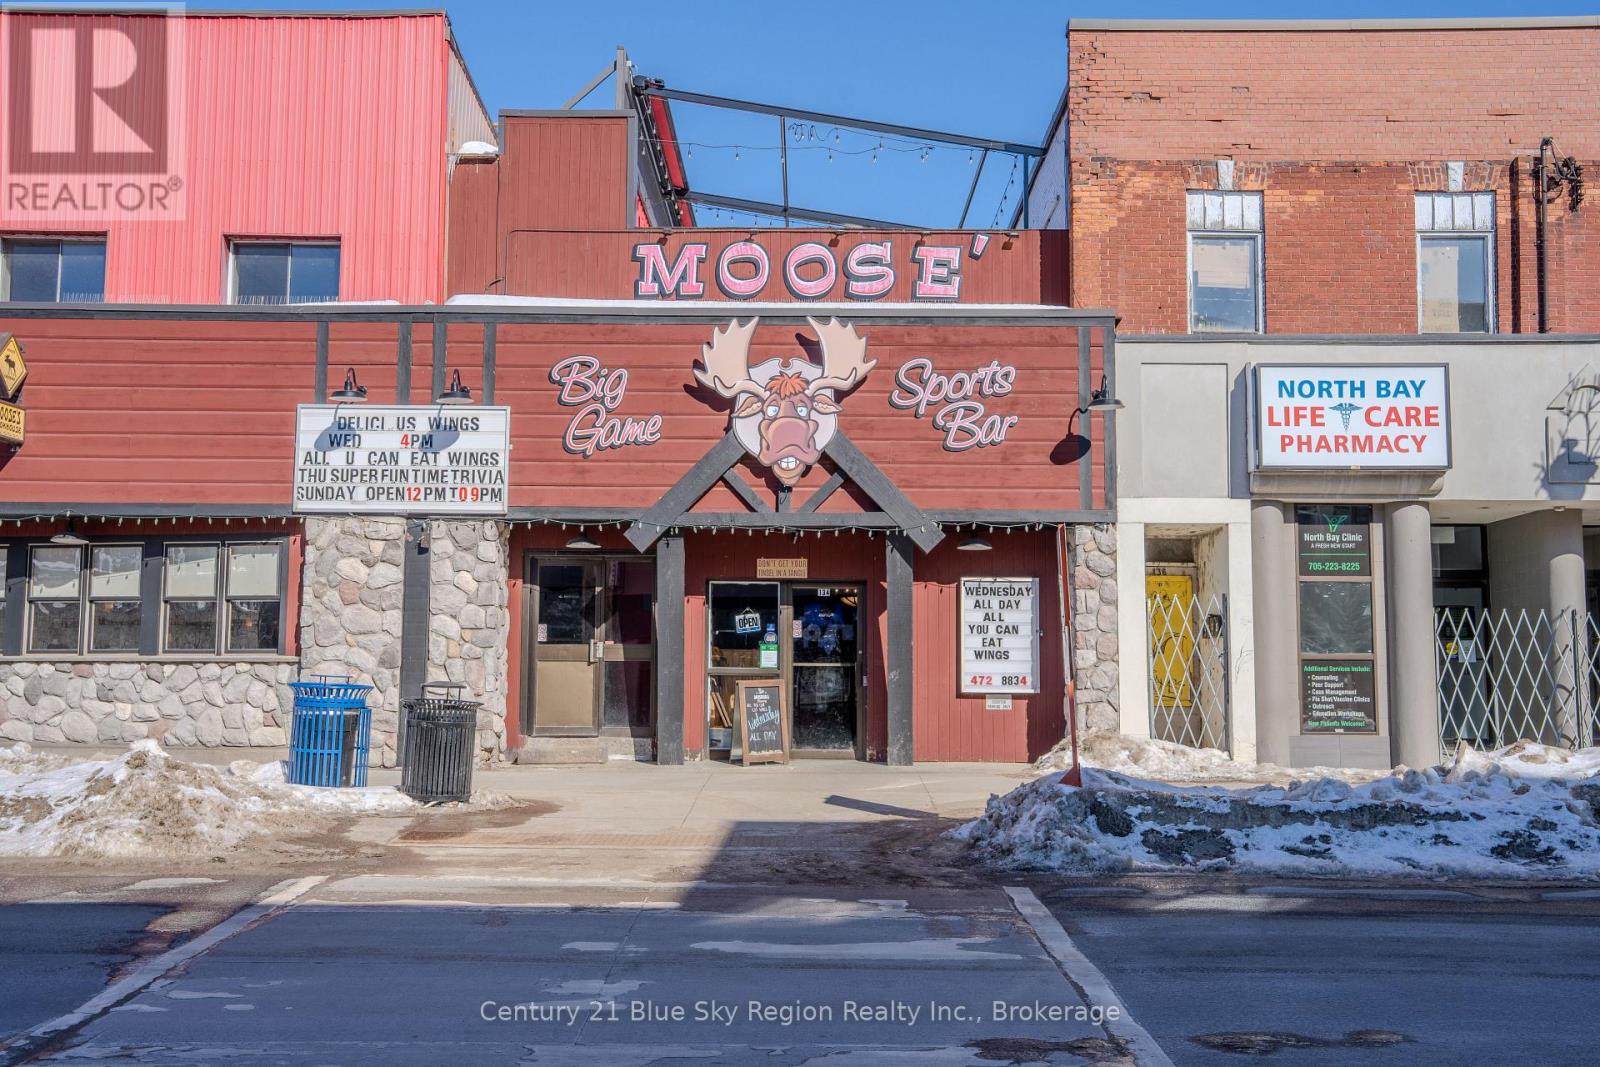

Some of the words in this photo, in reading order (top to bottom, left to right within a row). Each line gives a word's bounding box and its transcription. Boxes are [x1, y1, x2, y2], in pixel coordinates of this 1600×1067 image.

[549, 355, 628, 412] Big
[889, 358, 1016, 418] Sports
[1278, 379, 1365, 399] NORTH
[1376, 379, 1426, 399] BAY
[428, 416, 480, 431] WINGS
[1267, 405, 1326, 427] LIFE
[1364, 405, 1440, 427] CARE
[563, 403, 662, 459] Game
[933, 401, 1018, 452] Bar
[328, 433, 362, 448] WED
[400, 433, 433, 449] 4PM
[1280, 434, 1428, 453] PHARMACY
[303, 451, 330, 466] ALL
[346, 451, 355, 466] U
[368, 451, 400, 466] CAN
[411, 451, 440, 466] EAT
[448, 452, 500, 467] WINGS
[299, 468, 327, 483] THU
[330, 468, 379, 484] SUPER
[381, 469, 409, 484] FUN
[412, 469, 449, 484] TIME
[451, 469, 505, 485] TRIVIA
[296, 486, 356, 501] SUNDAY
[366, 486, 405, 501] OPEN
[1304, 533, 1324, 541] North
[1326, 533, 1340, 543] Bay
[1342, 533, 1363, 541] Clinic
[1308, 562, 1361, 571] 705-223-8225
[965, 586, 1032, 597] WEDNESDAY
[974, 599, 993, 610] ALL
[998, 599, 1021, 610] DAY
[738, 616, 759, 629] OPEN
[983, 612, 1005, 622] ALL
[969, 625, 989, 635] YOU
[995, 625, 1019, 635] CAN
[982, 638, 1003, 647] EAT
[974, 650, 1010, 660] WINGS
[970, 676, 993, 685] 472
[1001, 676, 1028, 685] 8834
